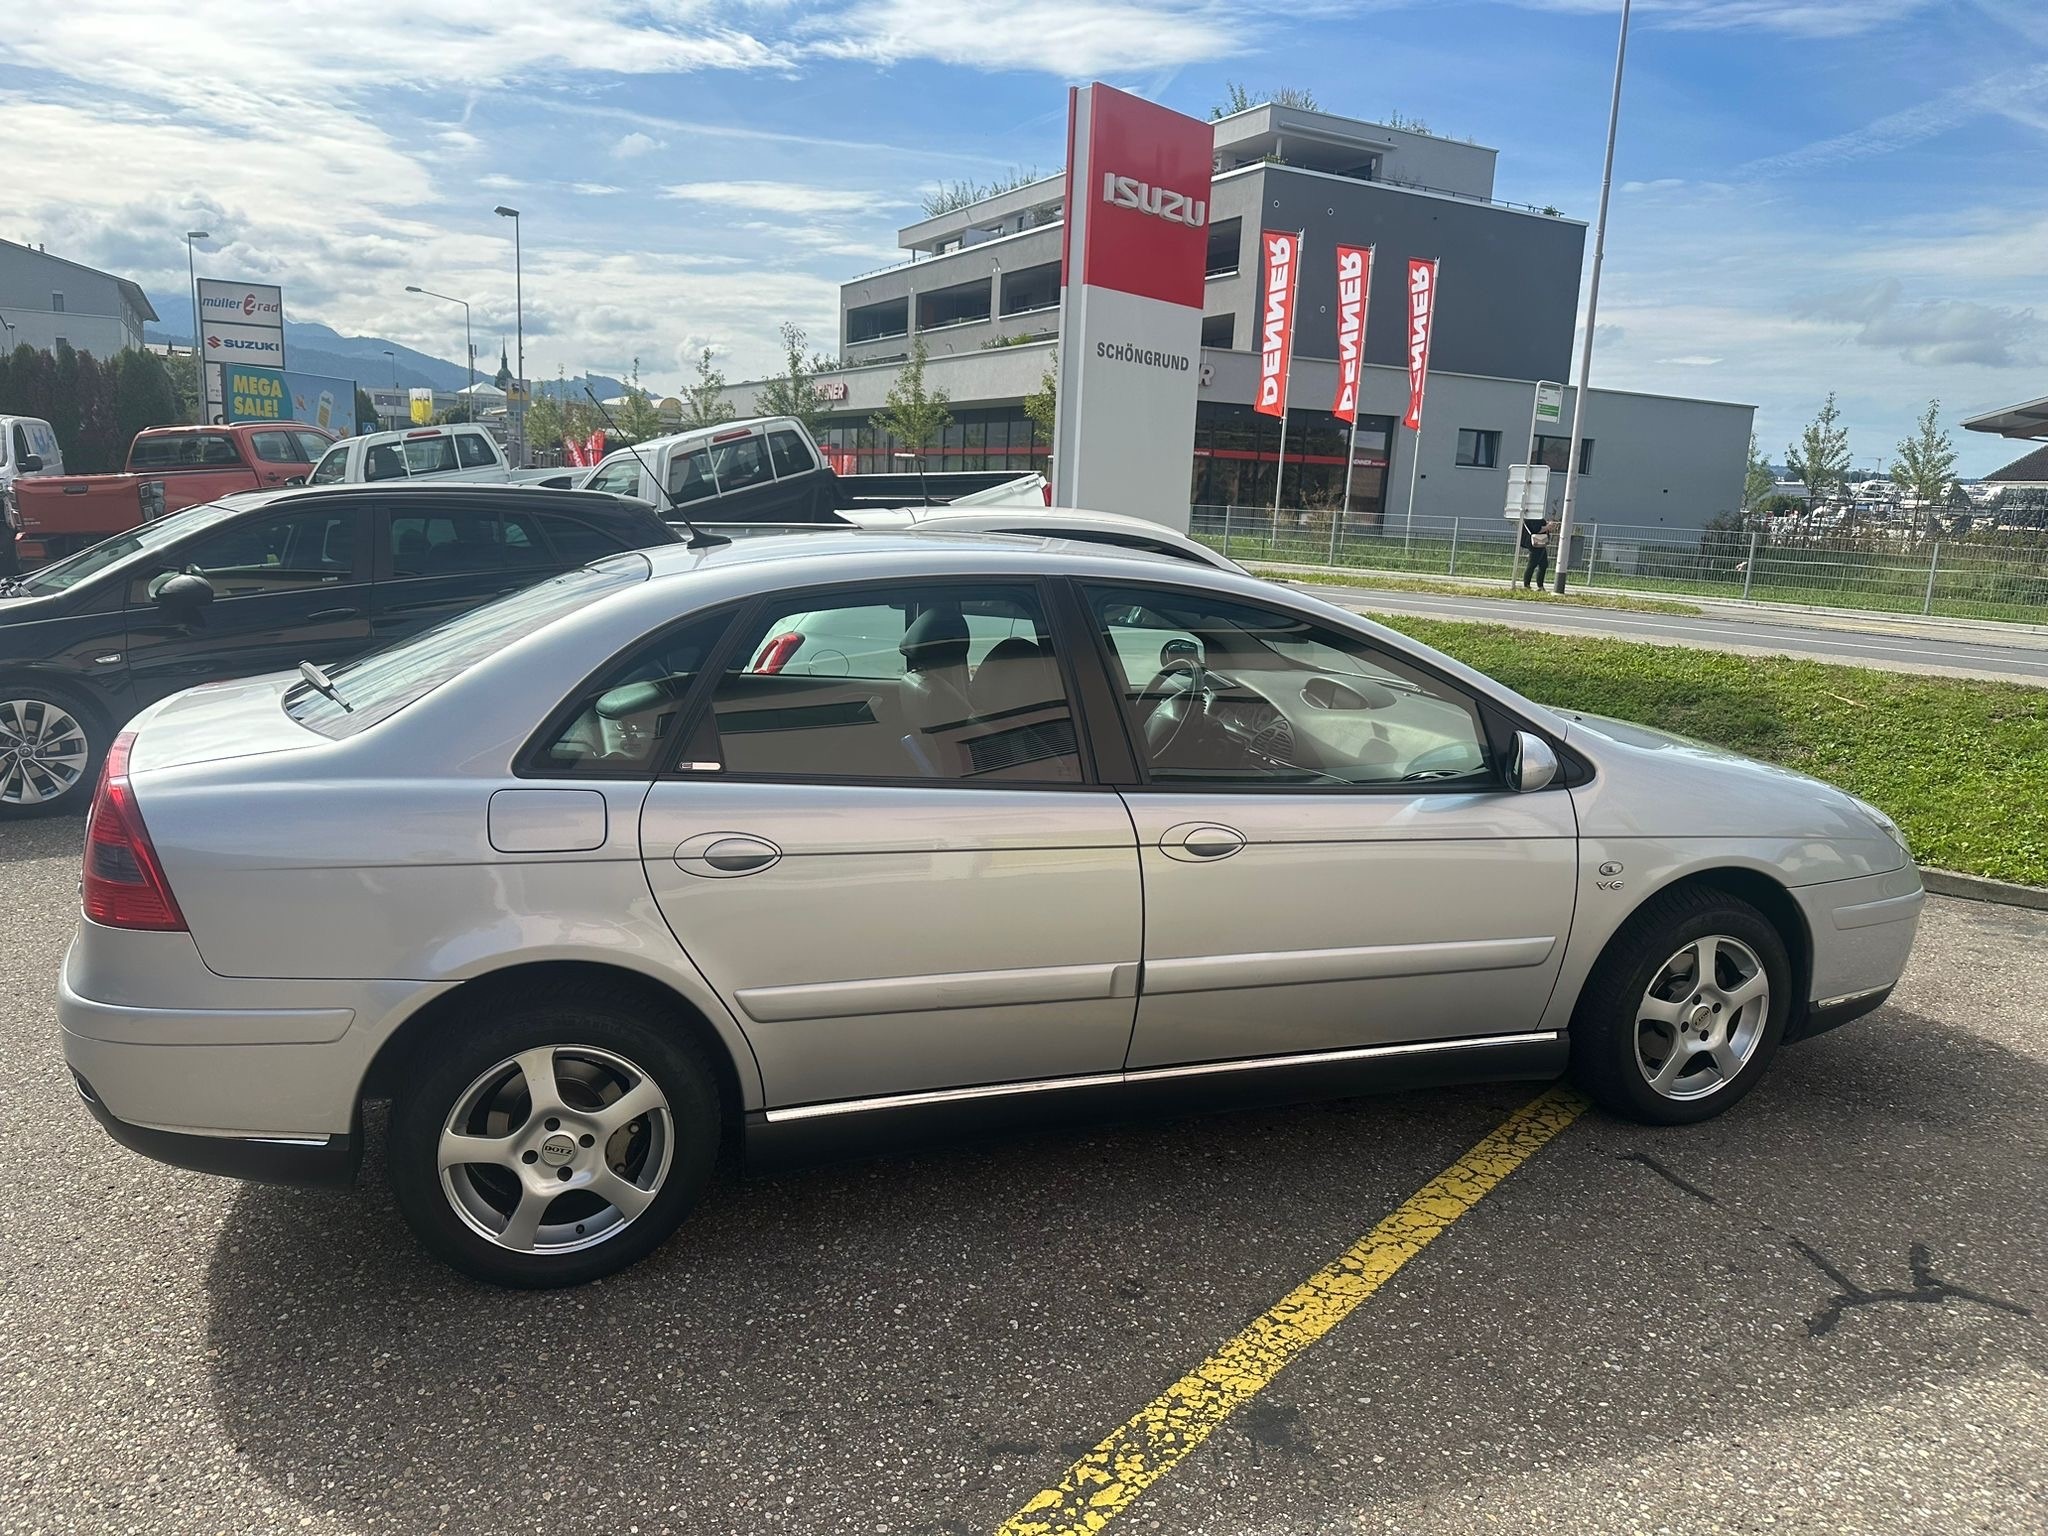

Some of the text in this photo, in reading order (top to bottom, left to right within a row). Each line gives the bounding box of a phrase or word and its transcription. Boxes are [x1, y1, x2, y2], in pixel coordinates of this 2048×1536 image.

[1103, 172, 1206, 228] ISUZU
[223, 338, 280, 352] SUZUKI
[1097, 341, 1190, 372] SCHÖNGRUND
[233, 374, 283, 398] MEGA
[233, 397, 279, 417] SALE!
[1596, 880, 1624, 890] V6
[544, 1145, 573, 1154] DOTZ
